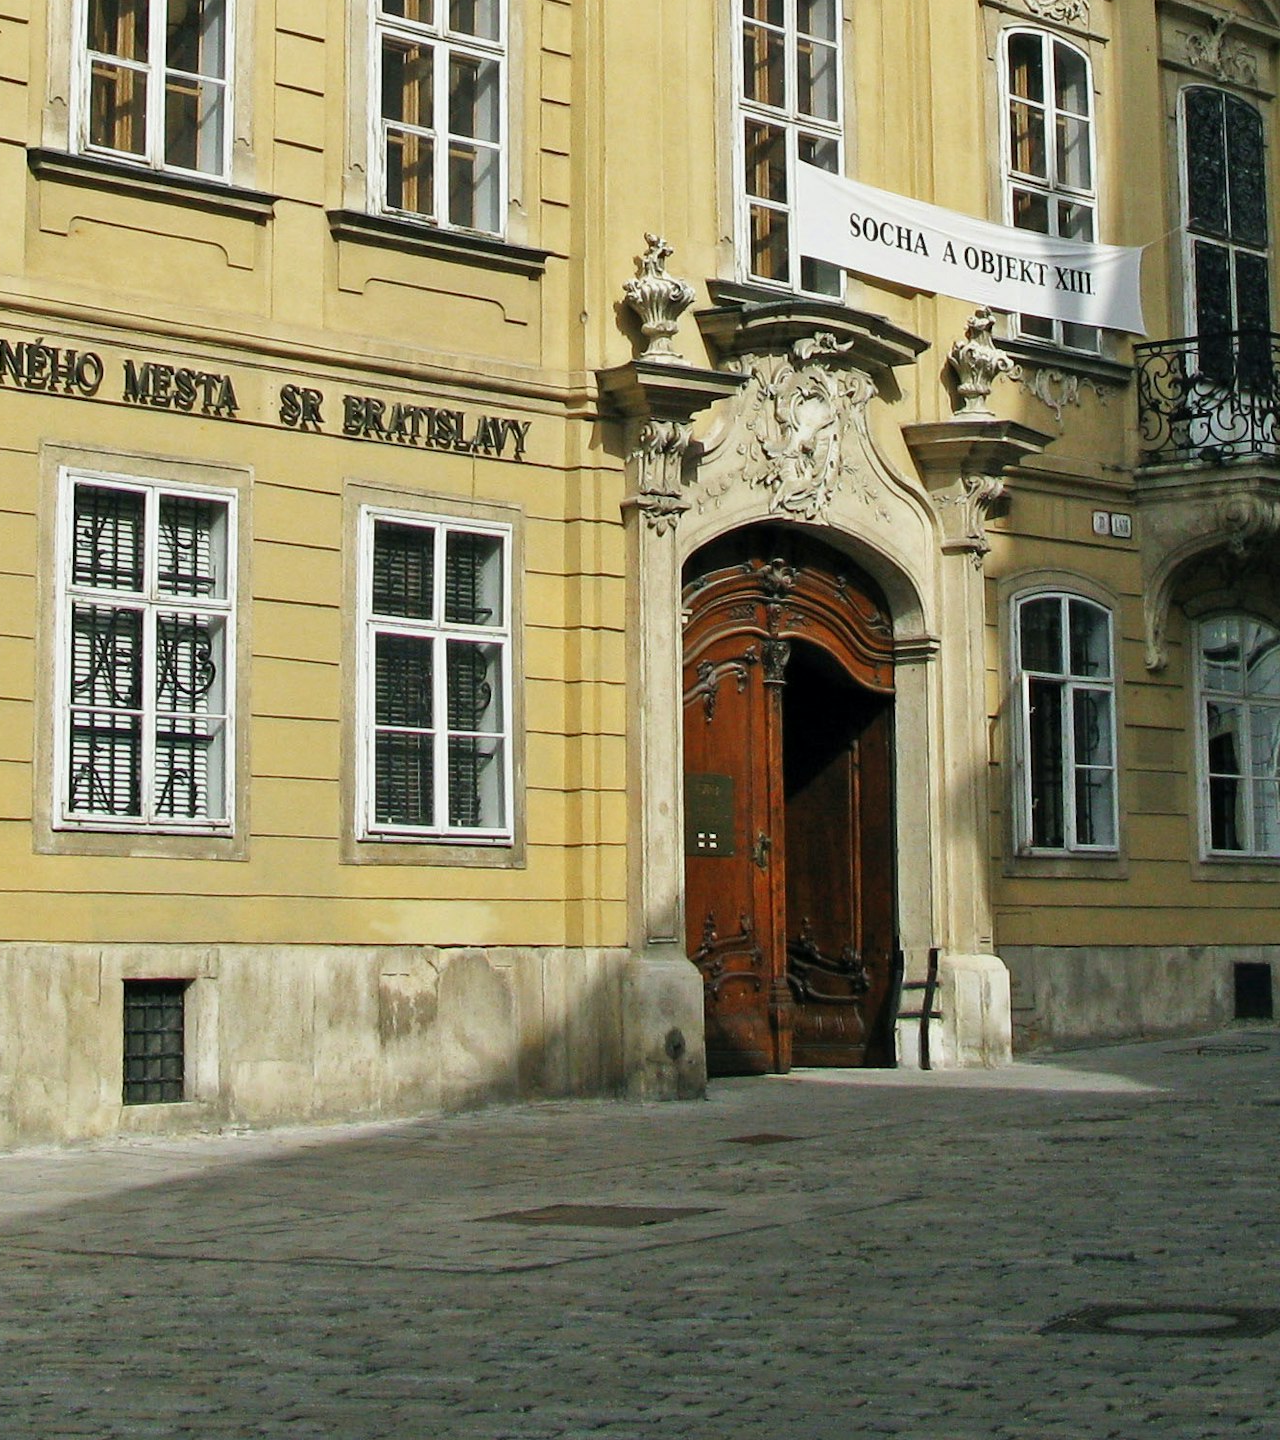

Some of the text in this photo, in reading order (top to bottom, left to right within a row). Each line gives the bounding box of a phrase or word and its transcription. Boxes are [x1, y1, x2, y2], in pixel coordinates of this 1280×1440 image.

[850, 212, 1096, 296] SOCHA A OBJEKT XIII.
[122, 359, 239, 418] MESTA
[278, 383, 324, 432] SR
[341, 394, 532, 460] BRATISLAVY
